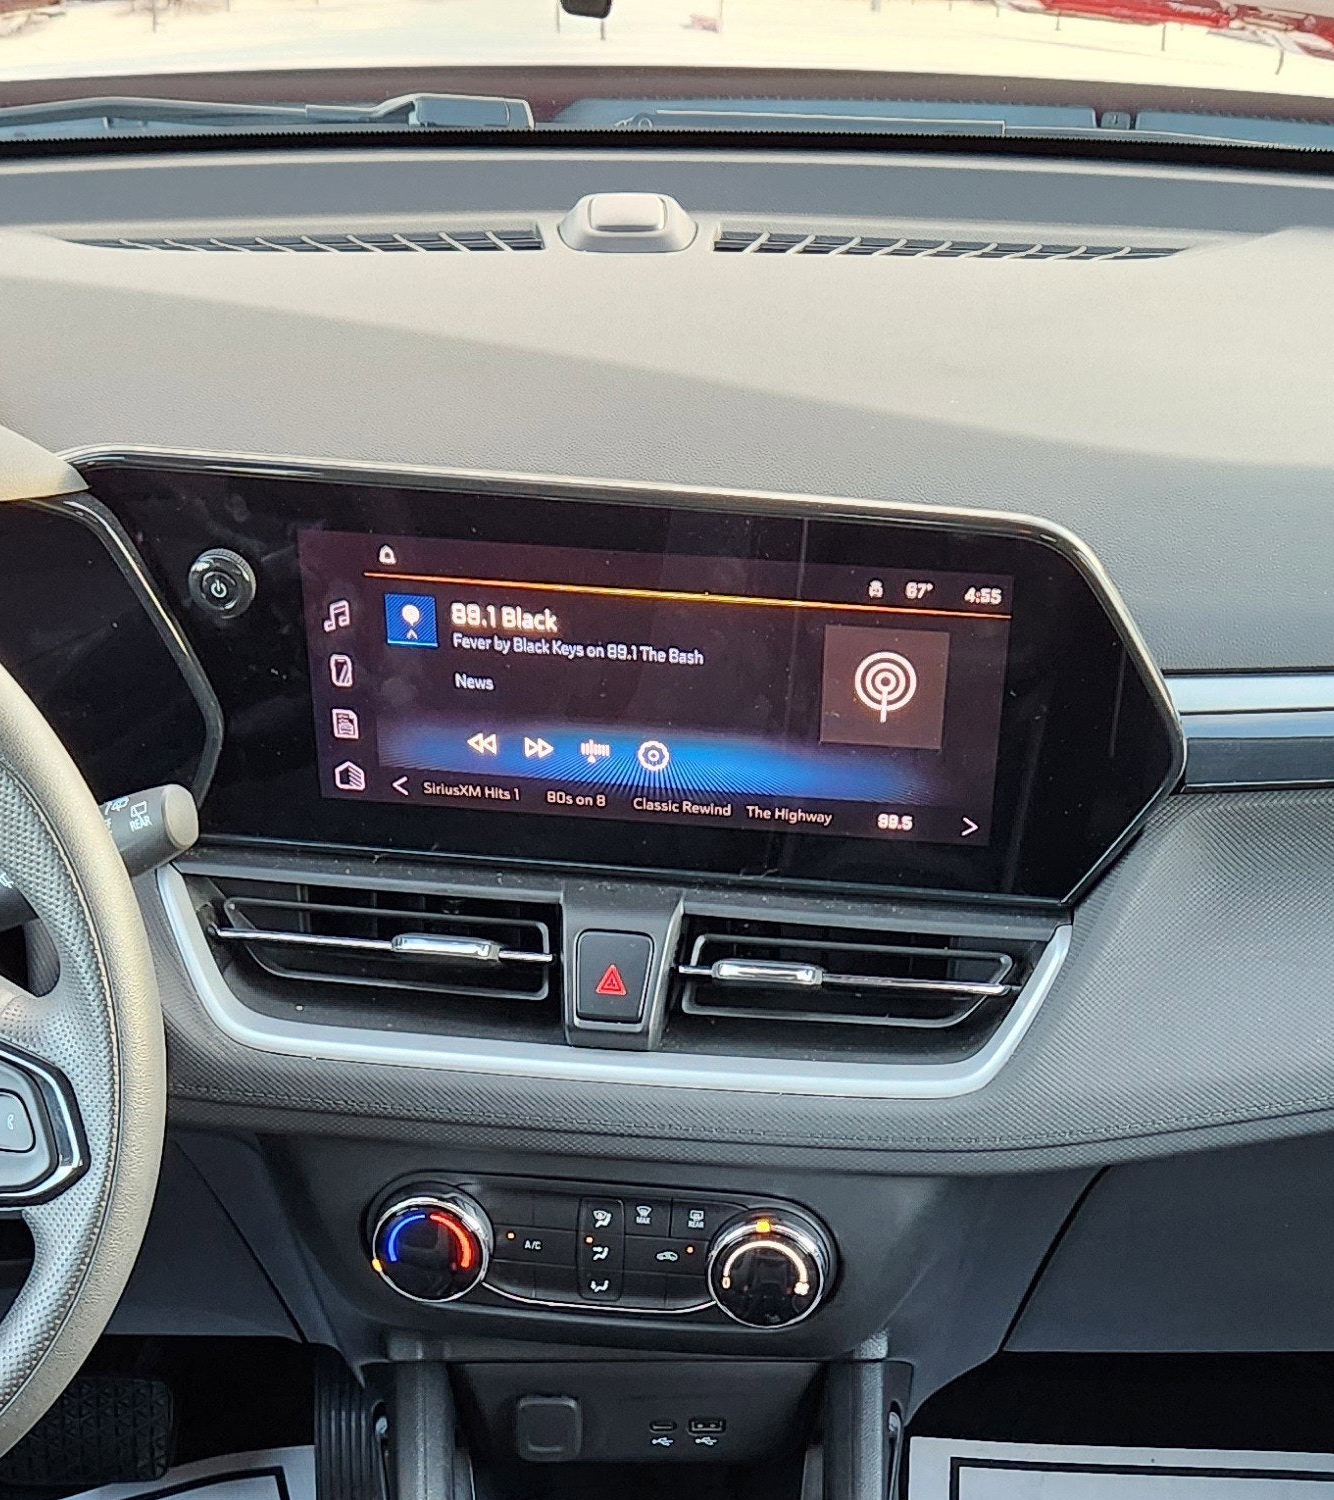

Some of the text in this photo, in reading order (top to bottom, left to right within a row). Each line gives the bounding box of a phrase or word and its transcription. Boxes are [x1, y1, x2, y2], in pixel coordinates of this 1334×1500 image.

[964, 586, 1003, 605] 4:55
[502, 605, 558, 633] Black
[453, 632, 705, 665] Fever by Black Keys on 89.1 The Bash
[454, 672, 495, 691] News
[423, 781, 482, 799] SiriusXM
[484, 786, 511, 800] Hits
[546, 790, 607, 807] 80s on 8
[633, 797, 732, 817] Classic Rewind
[746, 805, 833, 826] The Highway
[129, 815, 153, 832] REAR
[524, 1239, 542, 1251] A/C
